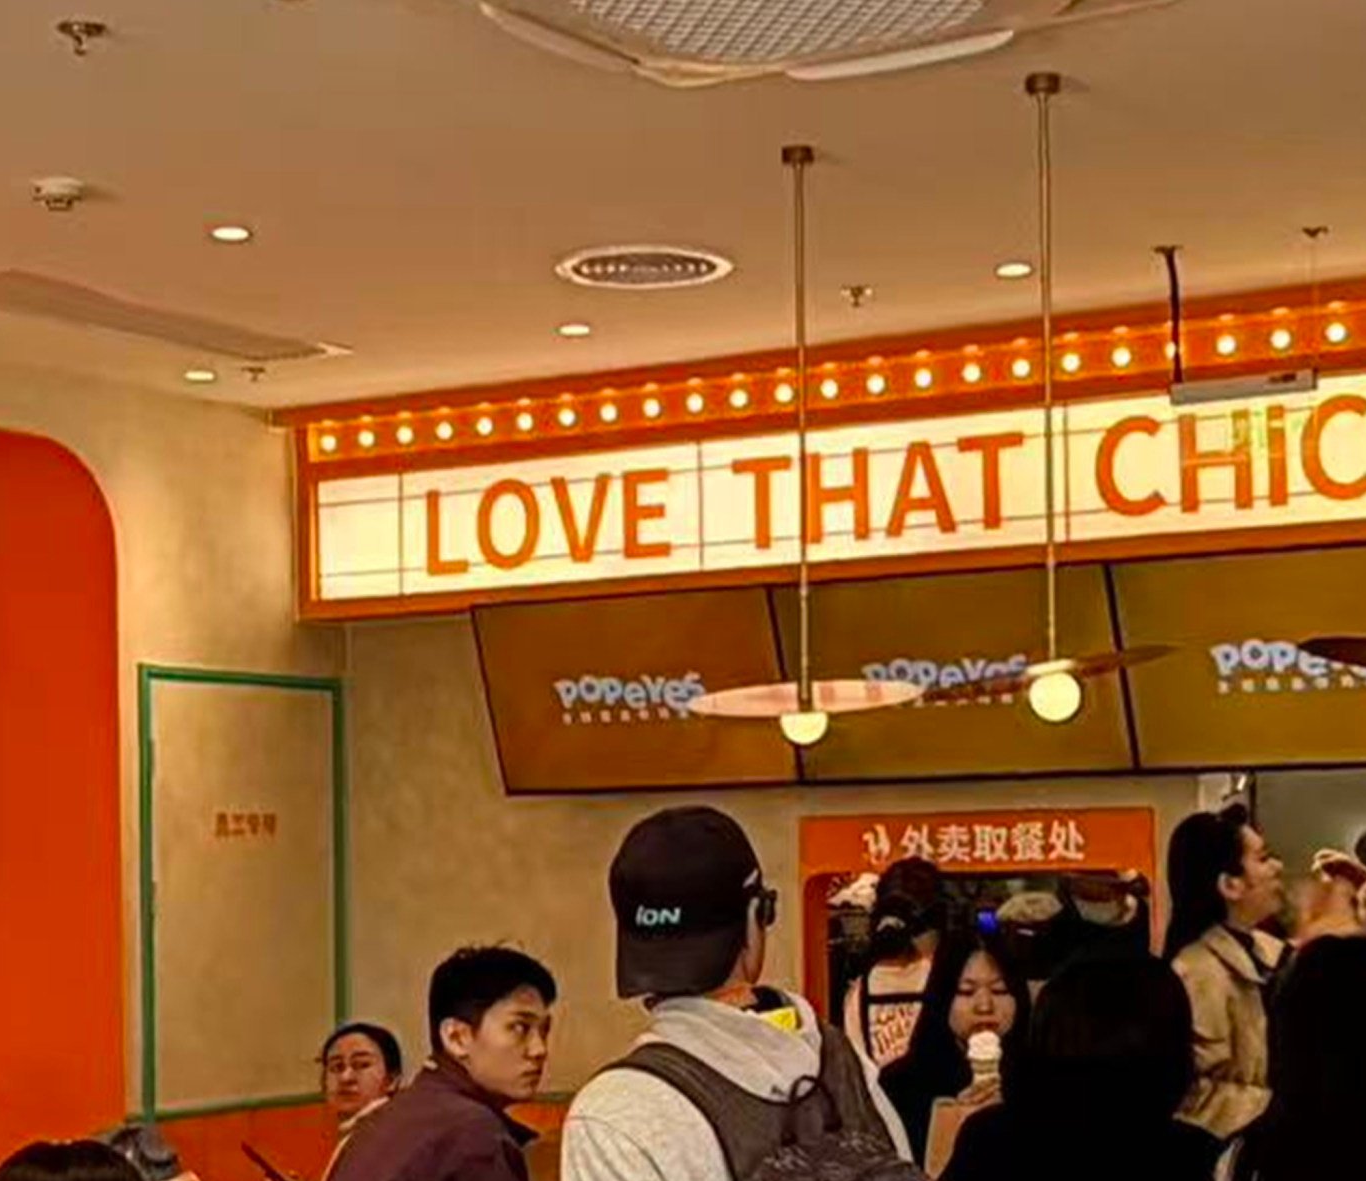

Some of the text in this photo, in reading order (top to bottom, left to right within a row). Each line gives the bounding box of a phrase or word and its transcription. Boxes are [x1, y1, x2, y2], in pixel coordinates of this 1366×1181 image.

[424, 468, 672, 577] LOVE
[732, 431, 1025, 551] THAT
[901, 820, 1087, 863] 外卖取餐处
